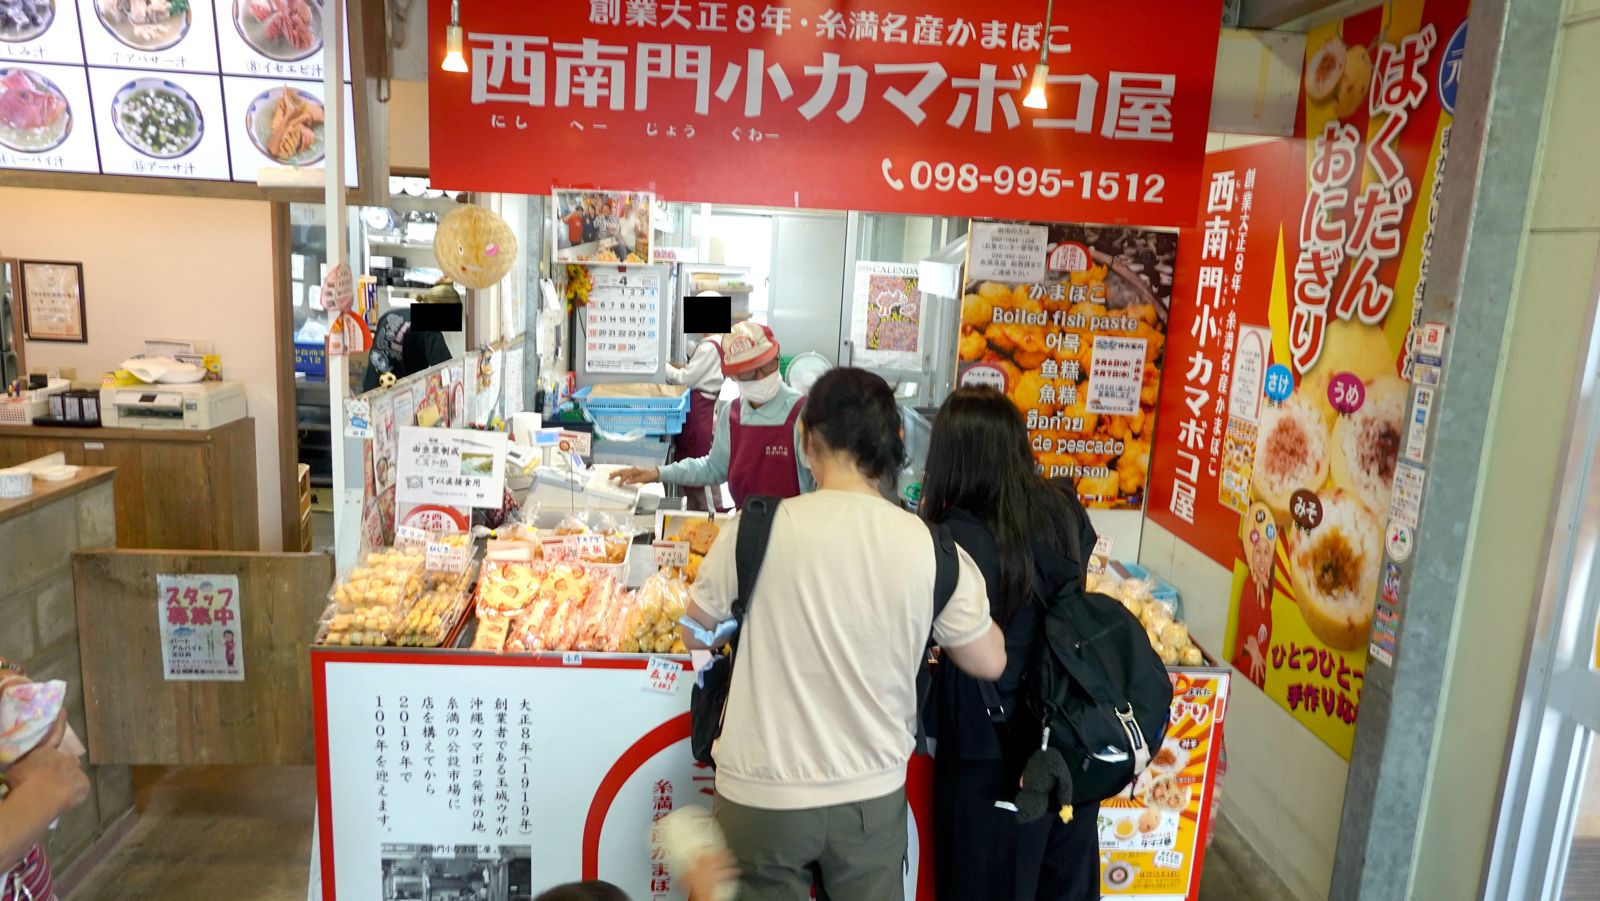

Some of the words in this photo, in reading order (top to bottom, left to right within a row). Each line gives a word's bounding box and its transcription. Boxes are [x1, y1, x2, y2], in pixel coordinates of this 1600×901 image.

[589, 0, 1072, 53] 創業大正8年・糸満名産かまぼこ
[468, 32, 1176, 142] 西南門小カマボコ屋
[491, 114, 528, 129] にし
[646, 123, 696, 138] じょう
[731, 128, 780, 142] ぐわー
[910, 160, 1165, 203] 098-995-1512
[1336, 22, 1437, 324] ばくだん
[1290, 121, 1359, 374] おにぎり
[619, 276, 627, 286] 4
[873, 265, 919, 275] CALENDA
[1029, 283, 1106, 304] かまぼこ
[992, 307, 1047, 326] Boiled
[1053, 310, 1086, 328] fish
[1090, 315, 1138, 332] paste
[1208, 168, 1256, 477] 創業大正8年・糸満名産かまぼこ
[1046, 332, 1079, 353] 어묵
[1169, 170, 1235, 524] 西南門小カマボコ屋
[1268, 372, 1289, 395] さけ
[1334, 381, 1359, 406] うめ
[1032, 434, 1052, 452] de
[1056, 438, 1124, 456] pescado
[1050, 461, 1109, 479] poisson
[1294, 496, 1317, 524] みそ
[166, 586, 233, 606] スタッフ
[166, 607, 234, 626] 募集中
[399, 696, 413, 783] 2019年で
[422, 696, 437, 795] 店を構えてから
[446, 697, 461, 810] 糸満の公設市場に
[375, 695, 392, 832] 100年を迎えます。
[470, 697, 486, 832] 沖縄カマボコ発祥の地
[495, 698, 509, 837] 創業者である玉城ウサが
[518, 699, 533, 835] 大正8年(1919年)
